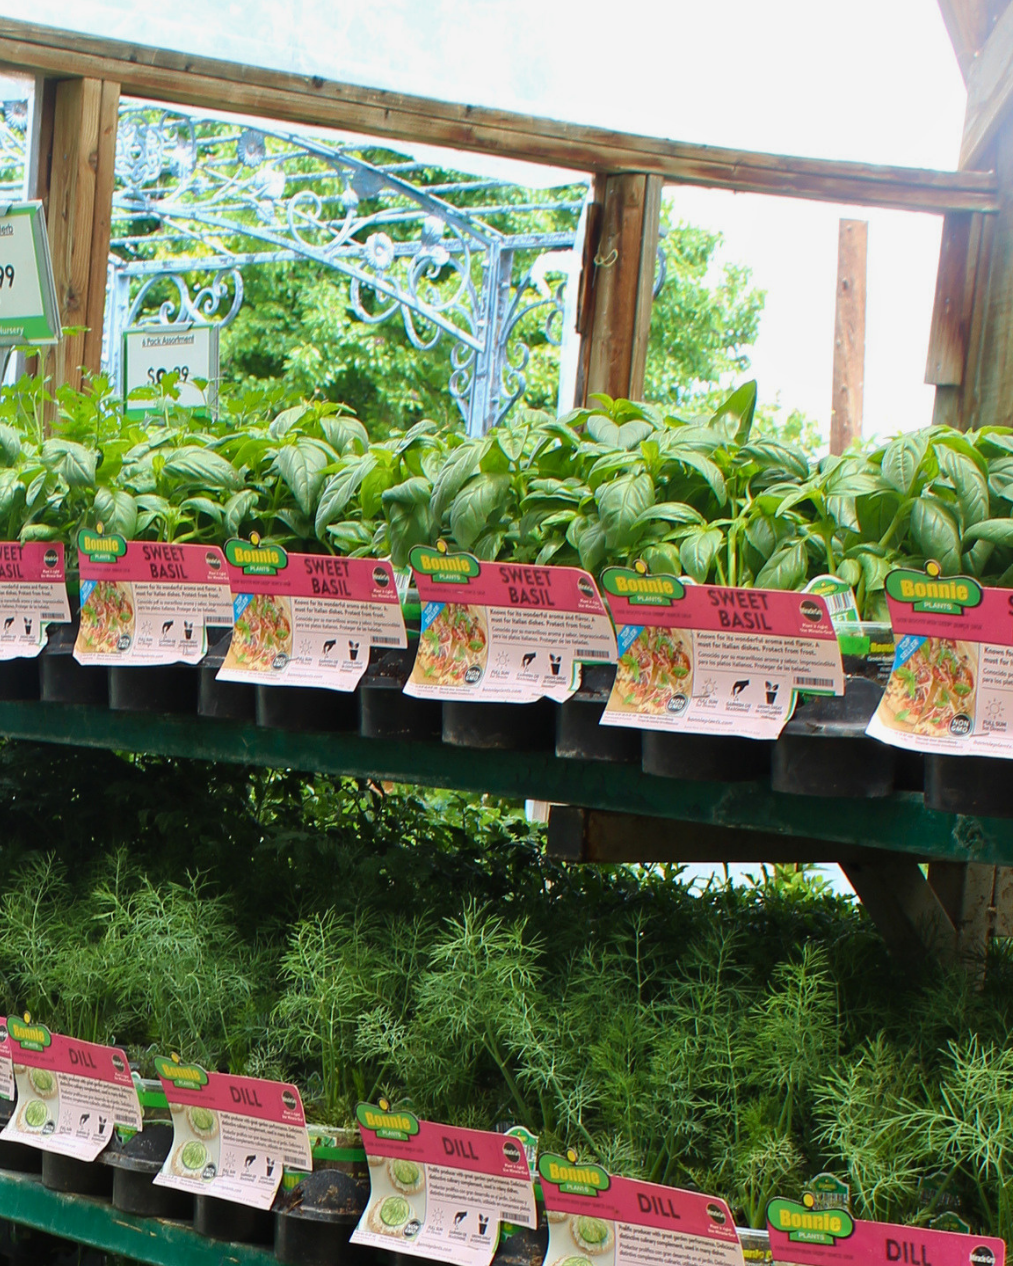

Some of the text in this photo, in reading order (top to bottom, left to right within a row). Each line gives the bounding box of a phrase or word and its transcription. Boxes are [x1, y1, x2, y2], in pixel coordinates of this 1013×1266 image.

[84, 535, 120, 552] Bonnie
[144, 545, 186, 562] SWEET
[234, 547, 280, 564] Bonnie
[150, 563, 188, 580] BASIL
[249, 565, 271, 573] PLANTS
[304, 558, 350, 578] SWEET
[420, 554, 471, 573] Bonnie
[438, 573, 461, 581] PLANTS
[499, 567, 552, 586] SWEET
[615, 576, 674, 595] Bonnie
[311, 578, 352, 597] BASIL
[508, 586, 556, 607] BASIL
[900, 579, 969, 600] Bonnie
[637, 595, 663, 603] PLANTS
[707, 589, 769, 610] SWEET
[923, 601, 952, 611] PLANTS
[718, 610, 773, 631] BASIL
[670, 698, 685, 706] NON
[950, 725, 968, 734] GMO
[952, 718, 970, 728] NON
[69, 1048, 97, 1069] DILL
[229, 1086, 263, 1108] DILL
[365, 1111, 411, 1131] Bonnie
[442, 1137, 479, 1160] DILL
[549, 1162, 600, 1185] Bonnie
[637, 1192, 681, 1219] DILL
[779, 1209, 842, 1232] Bonnie
[798, 1232, 825, 1240] PLANTS
